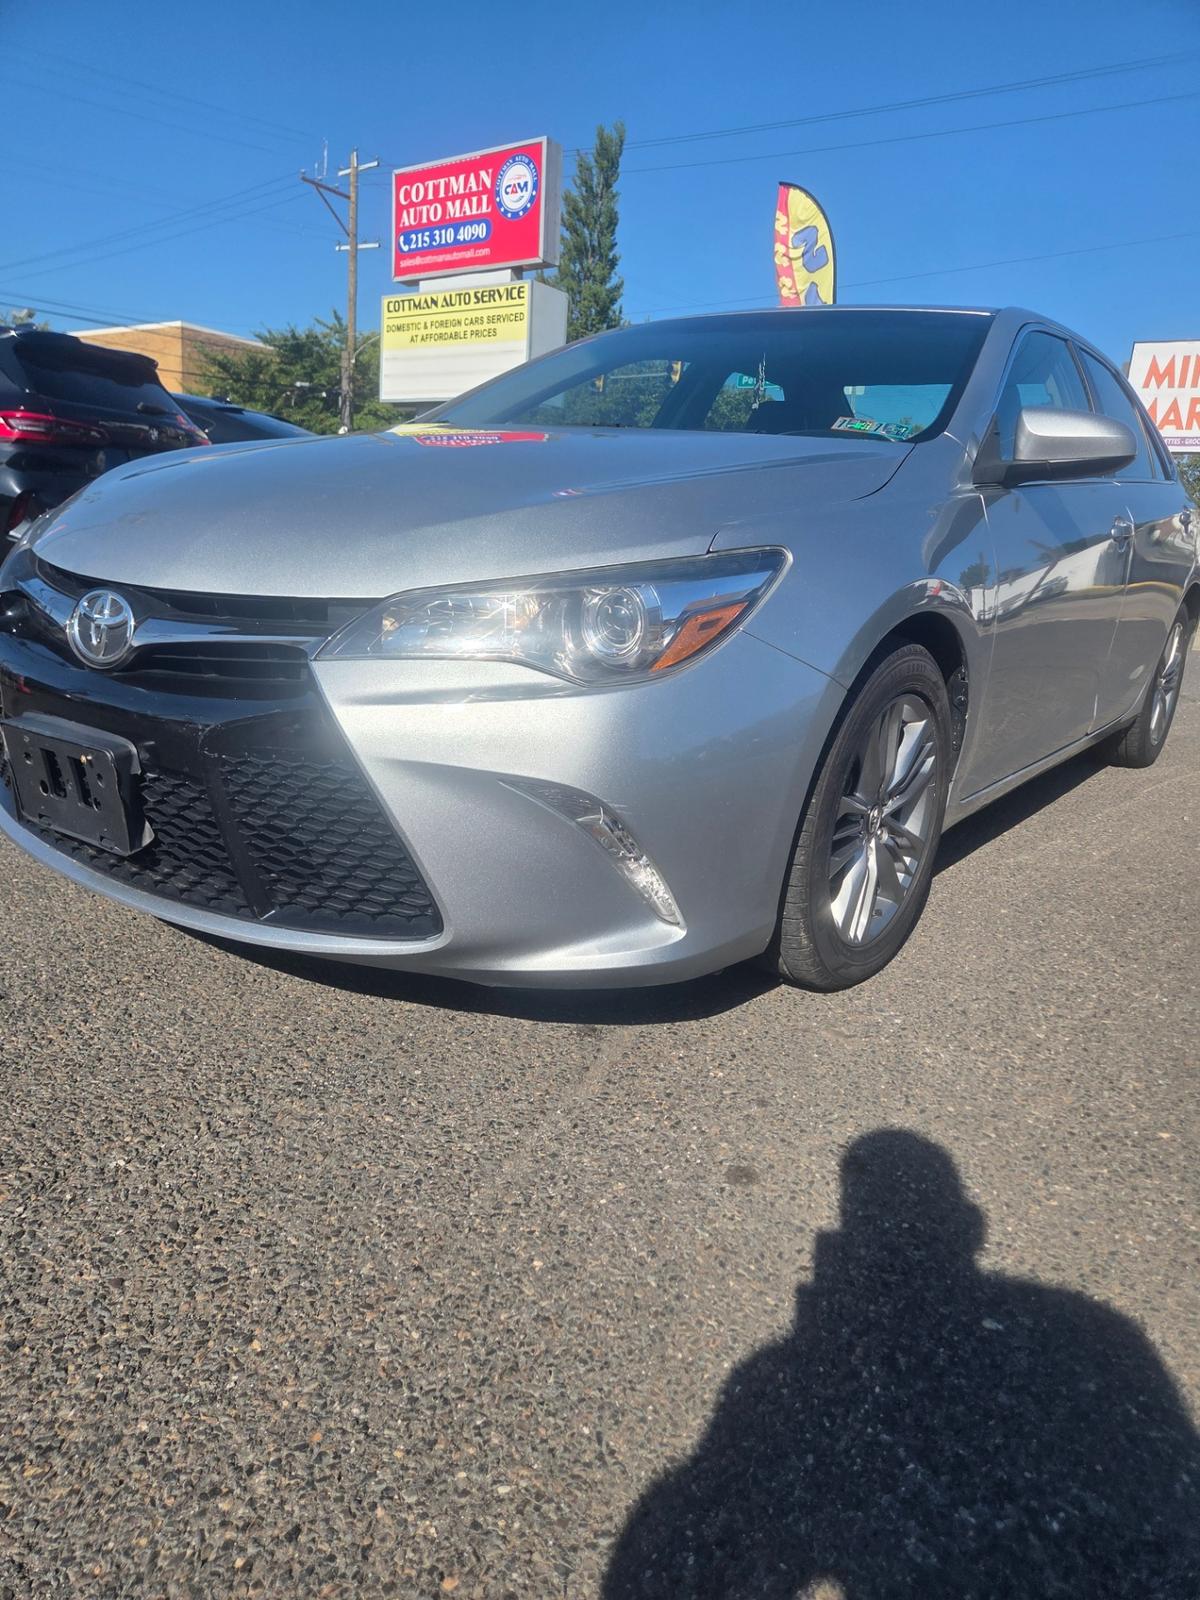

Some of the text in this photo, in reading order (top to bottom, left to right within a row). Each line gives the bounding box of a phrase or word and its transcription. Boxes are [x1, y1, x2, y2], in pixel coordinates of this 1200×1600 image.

[399, 169, 493, 205] COTTMAN
[400, 194, 492, 227] AUTO MALL
[410, 223, 487, 249] 215 310 4090
[387, 286, 525, 313] COTTMAN AUTO SERVICE
[386, 312, 525, 333] DOMESTIC & FOREIGN CARS SERVICED
[410, 327, 498, 343] AT AFFORDABLE PRICES
